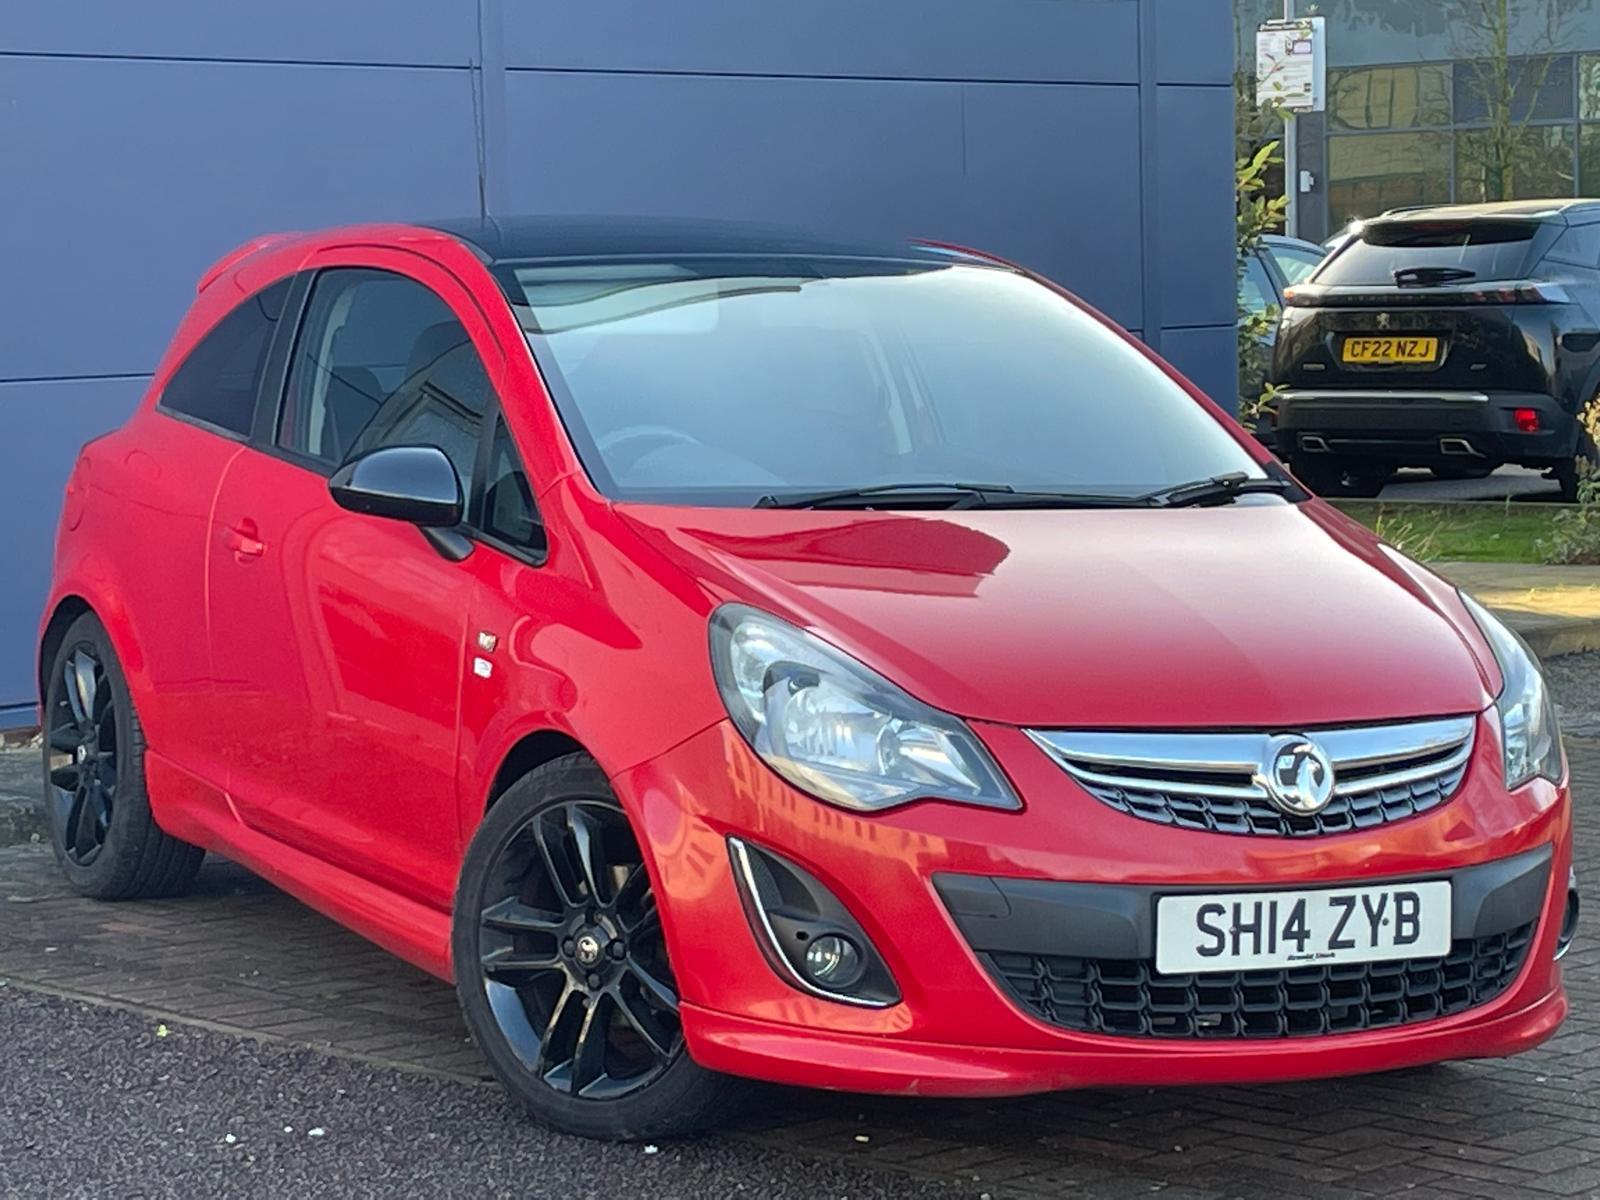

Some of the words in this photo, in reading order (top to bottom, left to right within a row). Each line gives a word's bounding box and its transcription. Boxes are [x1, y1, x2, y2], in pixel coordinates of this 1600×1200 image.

[1351, 341, 1392, 357] CF22
[1396, 341, 1430, 357] NZJ
[1196, 898, 1311, 957] SH14
[1328, 891, 1420, 950] ZYB
